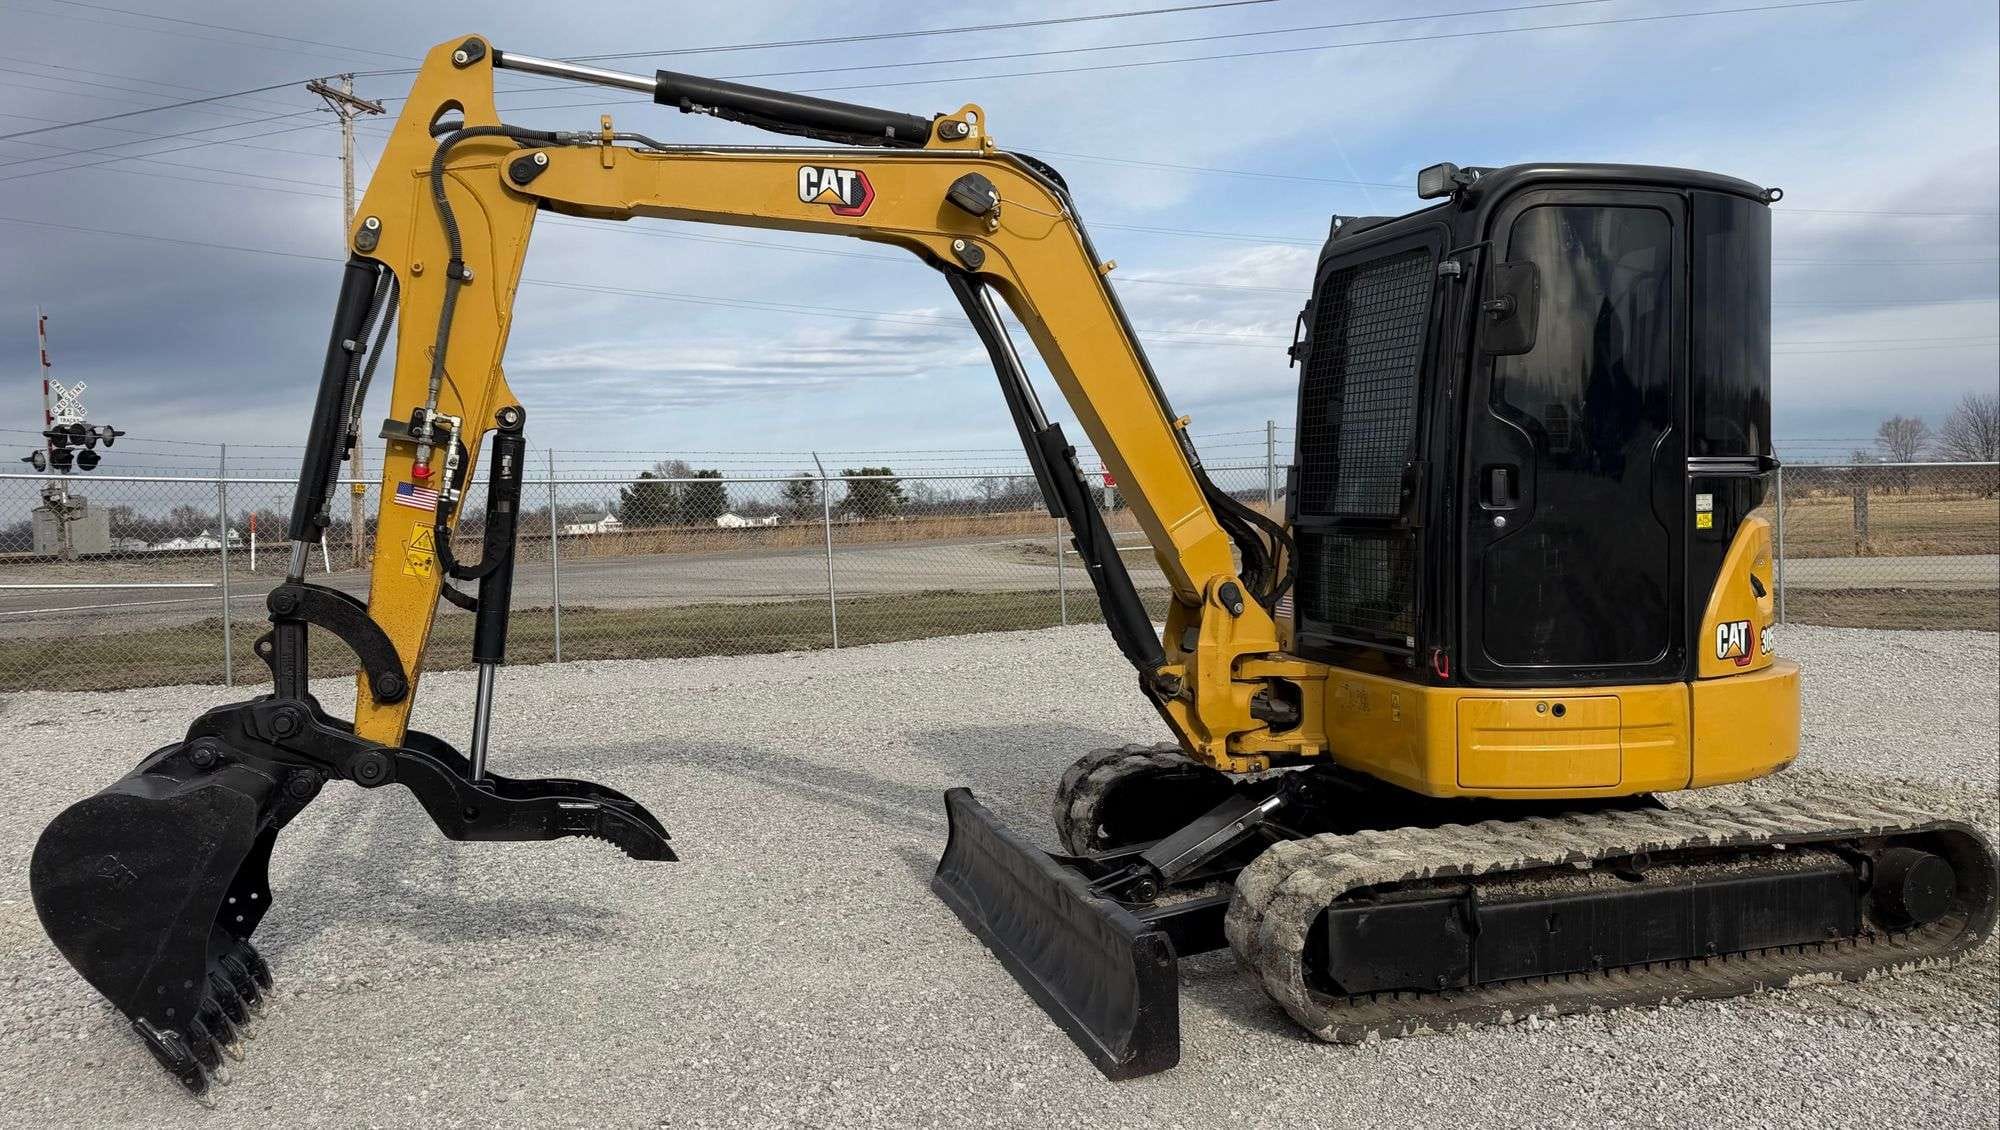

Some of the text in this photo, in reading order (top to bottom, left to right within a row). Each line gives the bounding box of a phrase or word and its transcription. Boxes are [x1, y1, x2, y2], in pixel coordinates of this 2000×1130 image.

[799, 166, 856, 205] CAT
[52, 382, 85, 414] CROSSING
[1717, 621, 1748, 659] CAT
